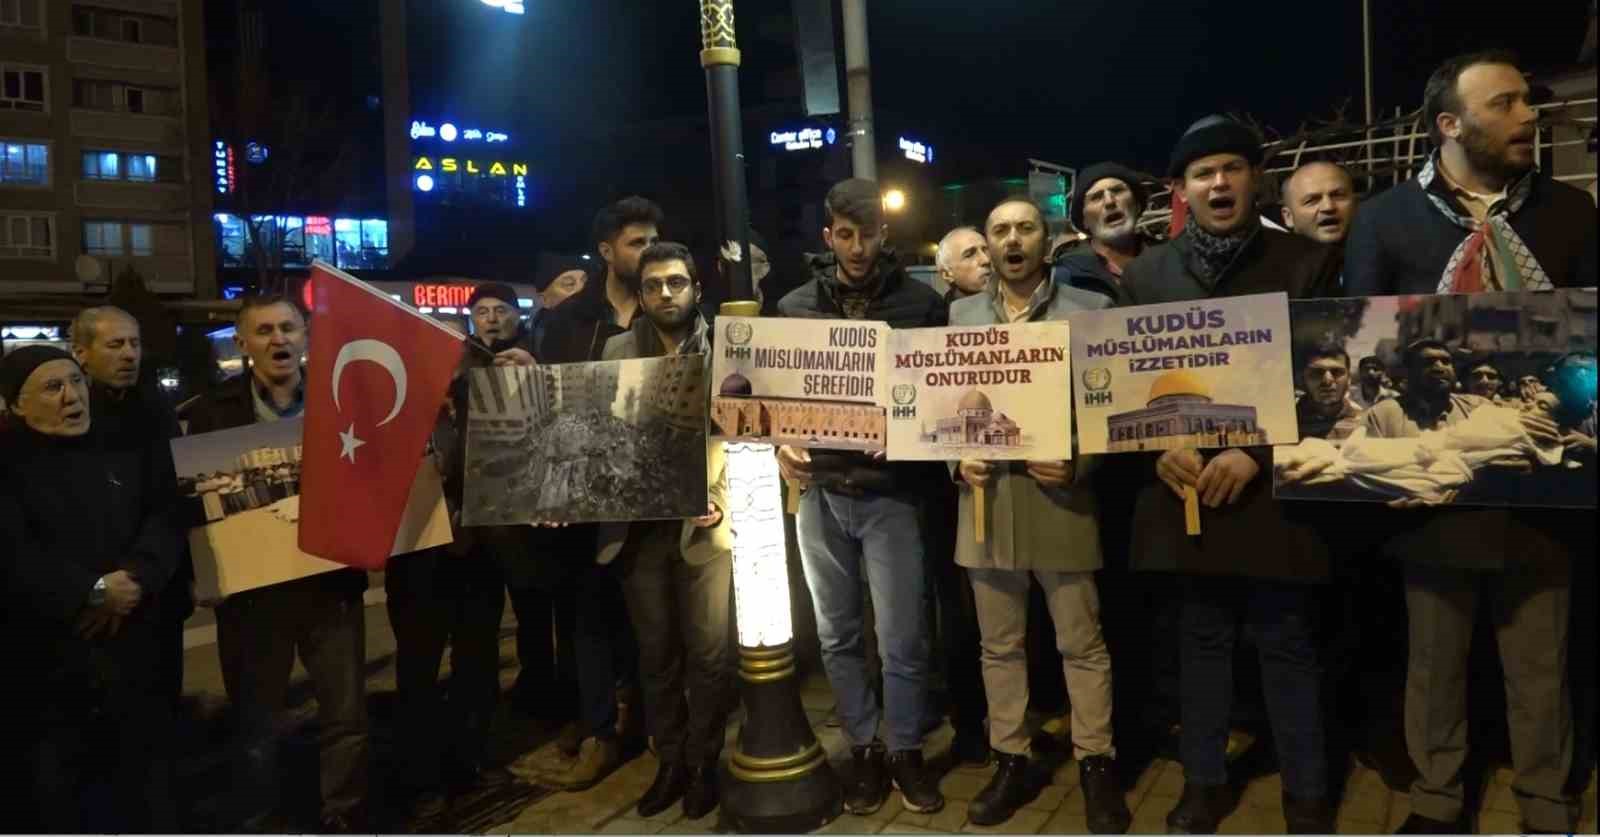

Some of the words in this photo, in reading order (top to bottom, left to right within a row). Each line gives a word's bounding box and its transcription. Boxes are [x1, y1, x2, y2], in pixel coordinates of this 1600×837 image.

[415, 156, 528, 176] ASLAN
[1126, 306, 1226, 337] KUDÜS
[829, 326, 877, 348] KUDÜS
[945, 327, 1010, 348] KUDÜS
[1087, 328, 1273, 358] MÜSLÜMANLARIN
[754, 345, 875, 373] MÜSLÜMANLARIN
[895, 346, 1065, 369] MÜSLÜMANLARIN
[926, 369, 1032, 387] ONURUDUR
